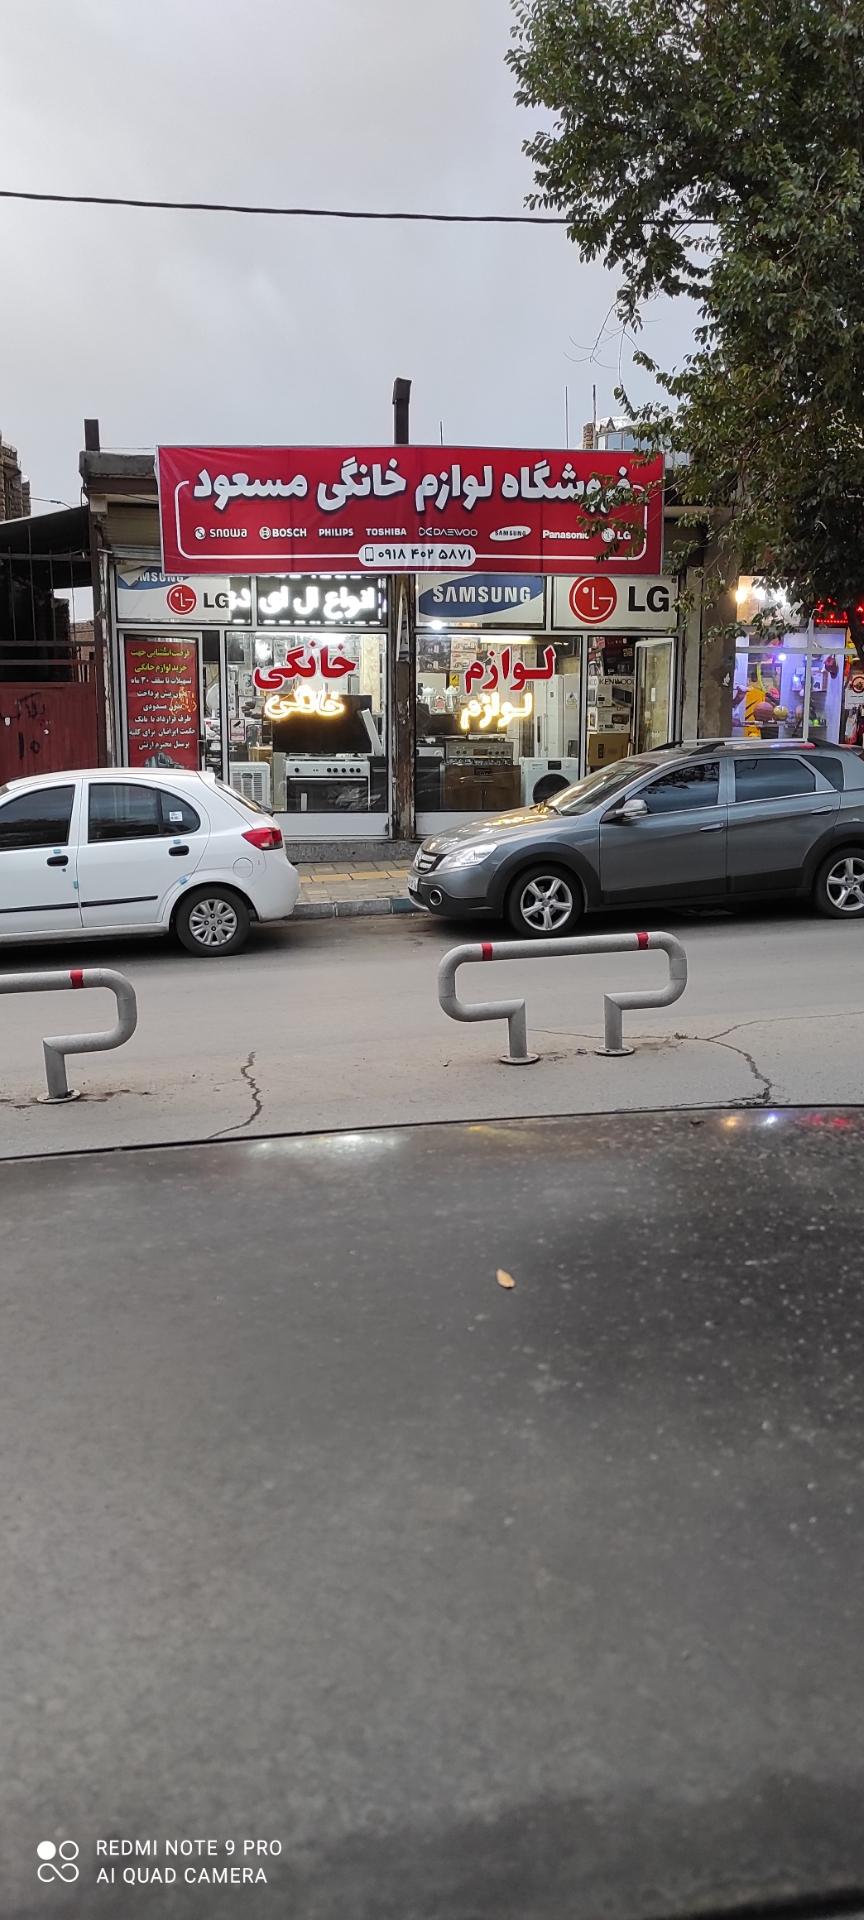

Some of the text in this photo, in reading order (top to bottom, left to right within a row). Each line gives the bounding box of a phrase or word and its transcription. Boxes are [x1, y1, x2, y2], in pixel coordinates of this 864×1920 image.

[193, 469, 308, 510] مسعود
[317, 456, 407, 511] خانگی
[415, 464, 493, 511] لوازم
[272, 528, 307, 538] BOSCH
[318, 528, 354, 537] PHILIPS
[366, 528, 407, 536] TOSHIBA
[433, 528, 478, 537] DAEWOO
[617, 531, 631, 540] LG
[378, 549, 472, 560] ۰۹۱۸ ۴۰۲ ۵۸۷۱
[203, 593, 229, 609] LG
[293, 586, 319, 614] ال
[432, 586, 532, 603] SAMSUNG
[628, 586, 669, 612] LG
[155, 664, 171, 673] لوازم
[172, 664, 188, 673] خرید
[253, 640, 357, 691] خانگی
[464, 645, 556, 695] لوازم
[136, 690, 160, 699] پرداخت
[460, 692, 533, 730] لوازم
[142, 728, 156, 737] برای
